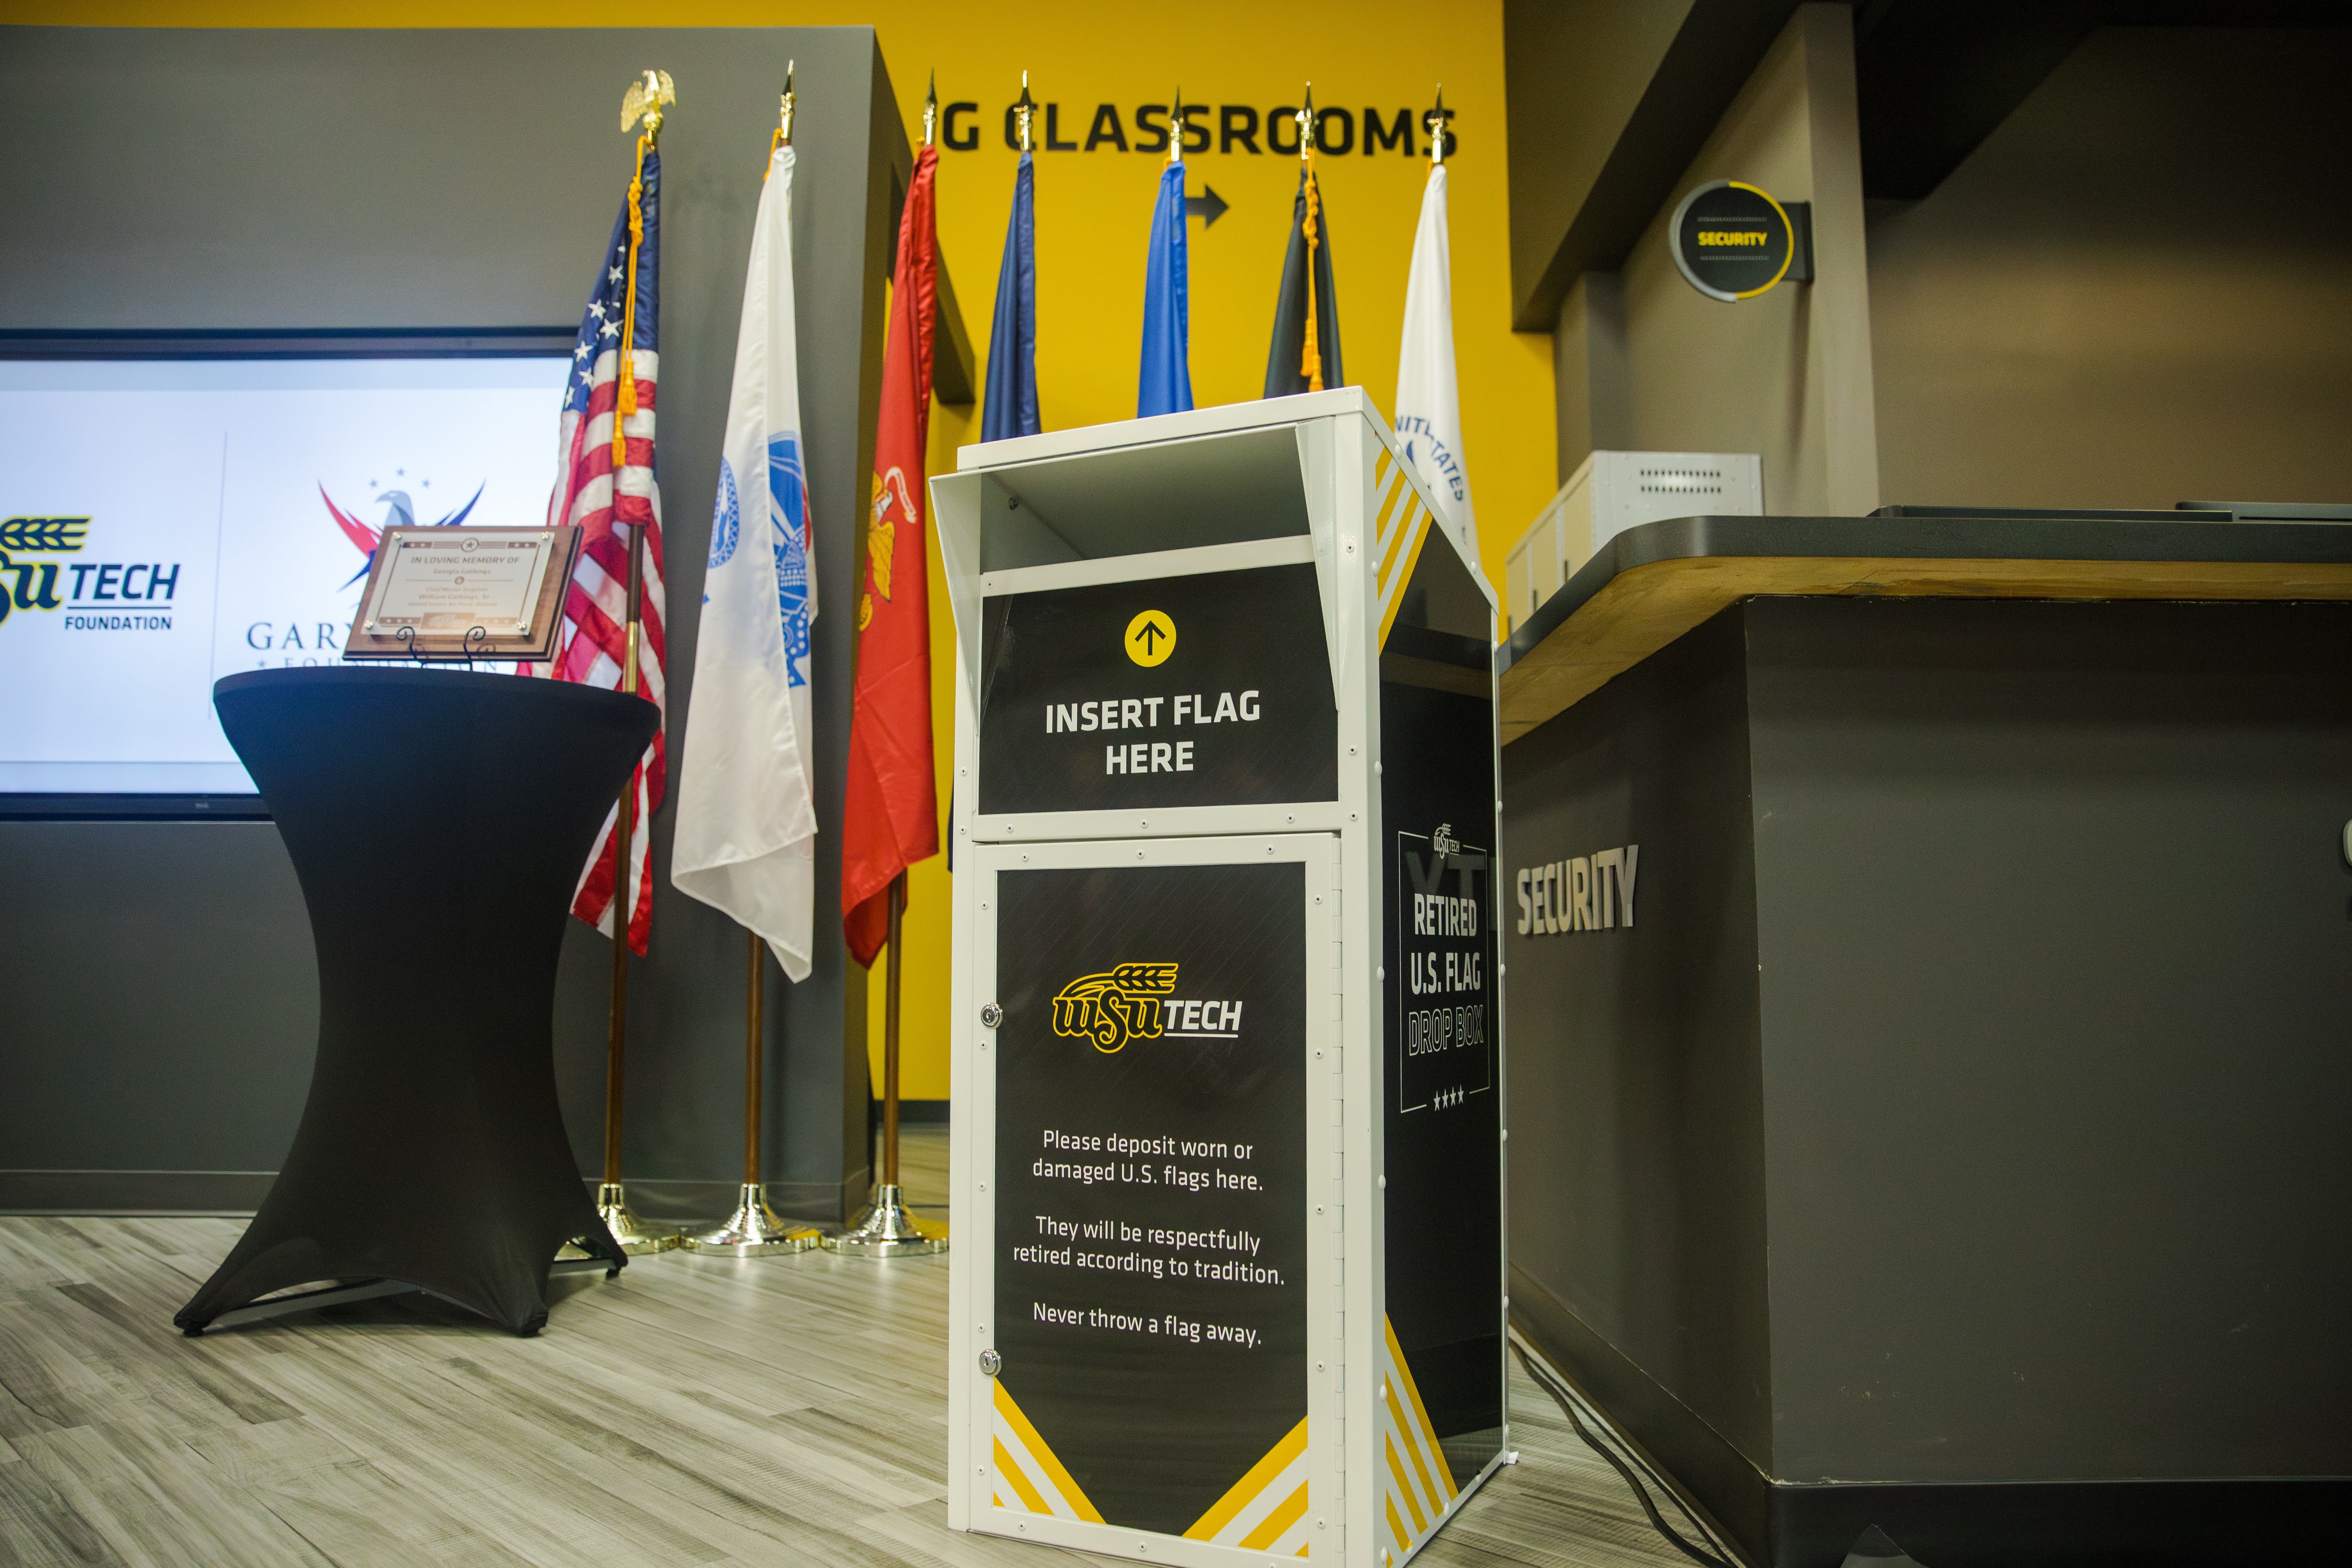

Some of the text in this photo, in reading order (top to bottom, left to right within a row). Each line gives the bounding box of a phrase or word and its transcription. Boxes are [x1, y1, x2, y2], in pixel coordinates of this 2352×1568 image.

[1005, 103, 1457, 157] CLASSROOMS
[1698, 232, 1767, 246] SECURITY
[70, 564, 181, 600] TECH
[65, 617, 172, 630] FOUNDATION
[247, 622, 351, 650] GAR
[1047, 691, 1259, 733] INSERT FLAG
[1107, 742, 1193, 774] HERE
[1449, 839, 1460, 852] TECH
[1517, 844, 1639, 935] SECURITY
[1415, 893, 1476, 936] RETIRED
[1411, 952, 1480, 995] U.S. FLAG
[1164, 1000, 1242, 1031] TECH
[1409, 1005, 1483, 1056] DROP BOX
[1044, 1130, 1252, 1159] Please deposit worn or
[1033, 1158, 1262, 1191] damaged U.S. flags here.
[1036, 1216, 1260, 1256] They will be respectfully
[1014, 1245, 1284, 1284] retired according to tradition.
[1034, 1302, 1260, 1348] Never throw a flag away.
